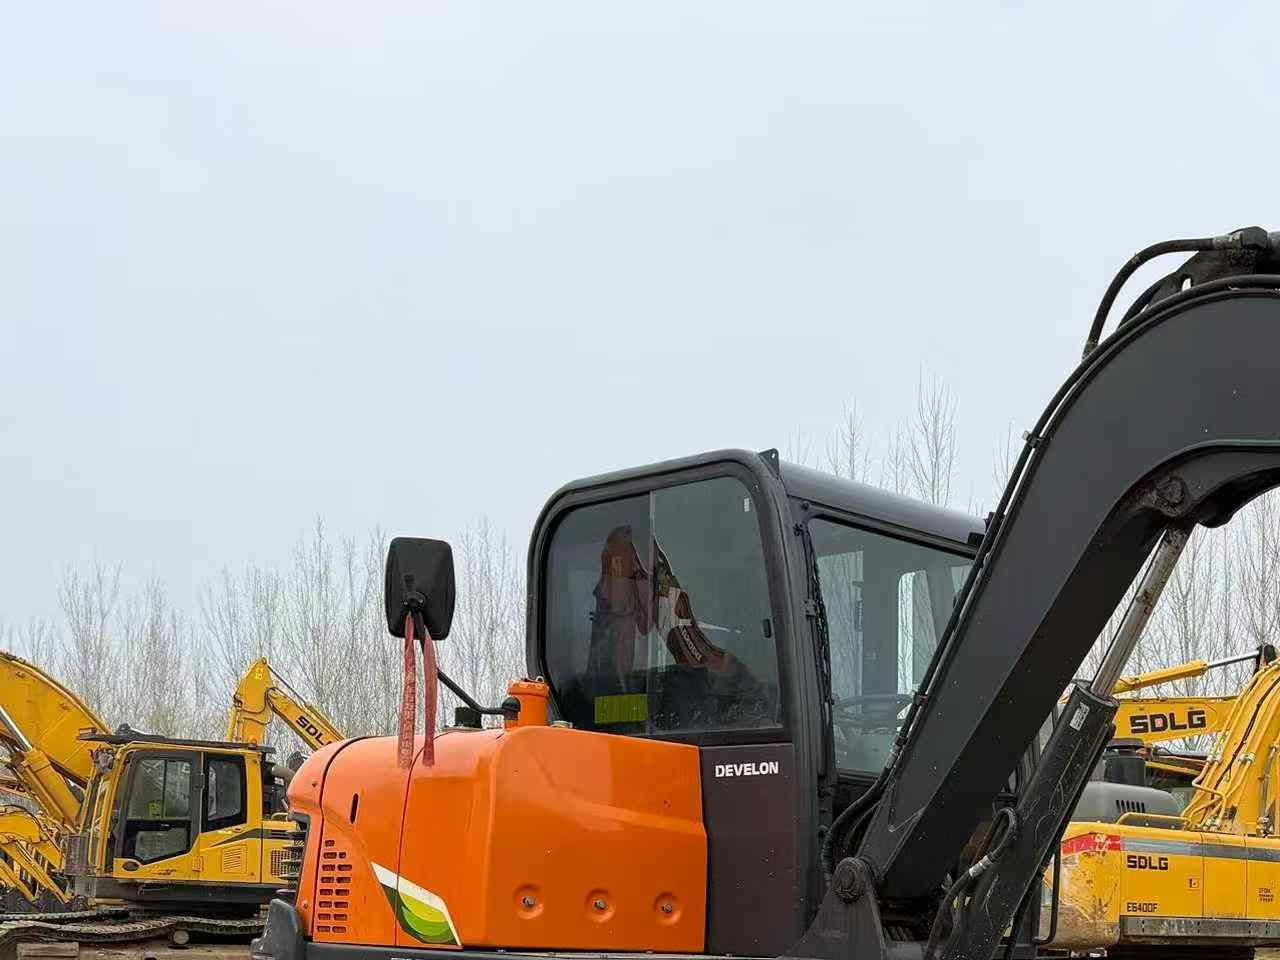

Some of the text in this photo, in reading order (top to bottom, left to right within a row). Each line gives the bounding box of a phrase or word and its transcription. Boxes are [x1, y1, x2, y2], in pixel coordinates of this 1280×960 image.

[1129, 709, 1207, 734] SDLG
[296, 715, 333, 746] SDL
[715, 761, 779, 777] DEVELON
[1126, 855, 1169, 870] SDLG
[1126, 902, 1158, 913] E6400F
